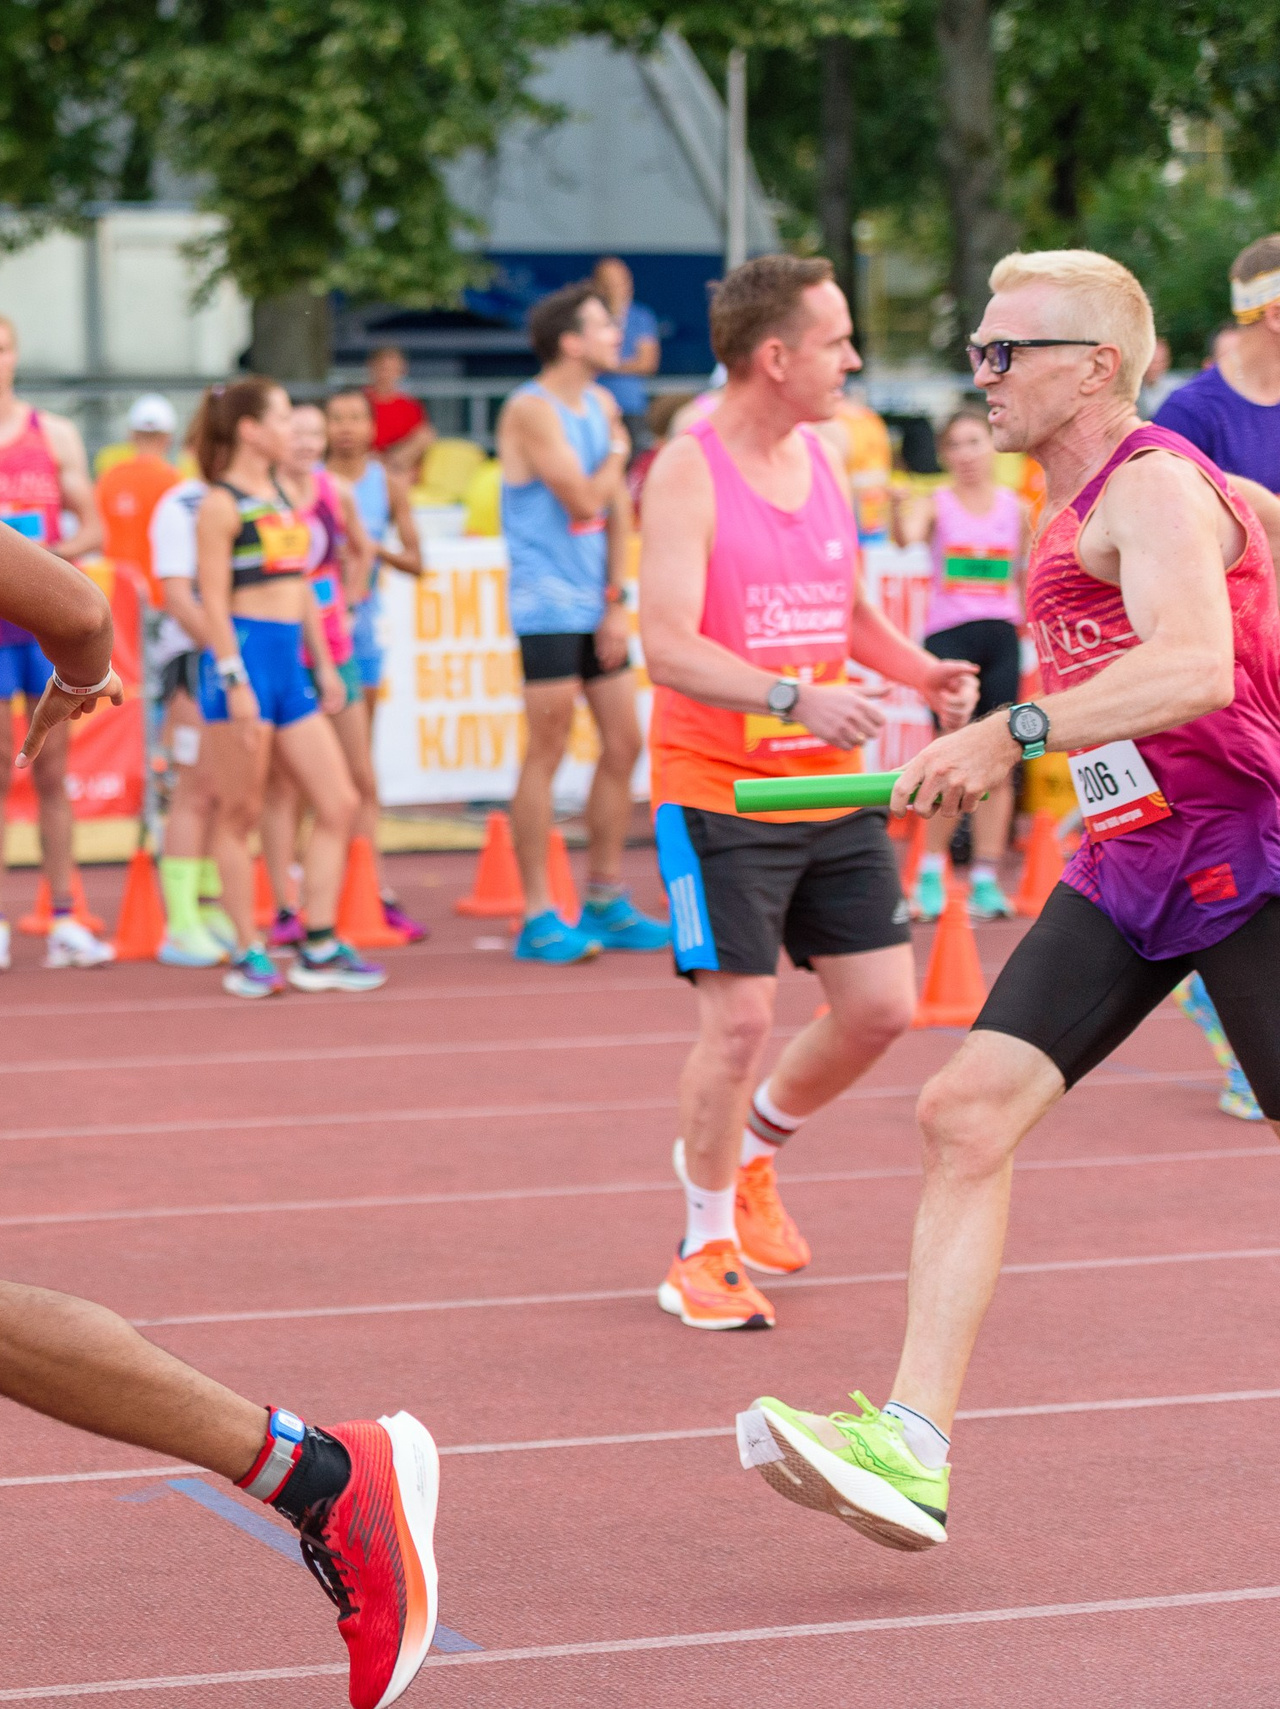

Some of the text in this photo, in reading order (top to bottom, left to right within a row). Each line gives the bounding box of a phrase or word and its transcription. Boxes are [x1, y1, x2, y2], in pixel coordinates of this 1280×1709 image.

[745, 580, 847, 607] RUNNING
[1078, 761, 1137, 804] 206 1
